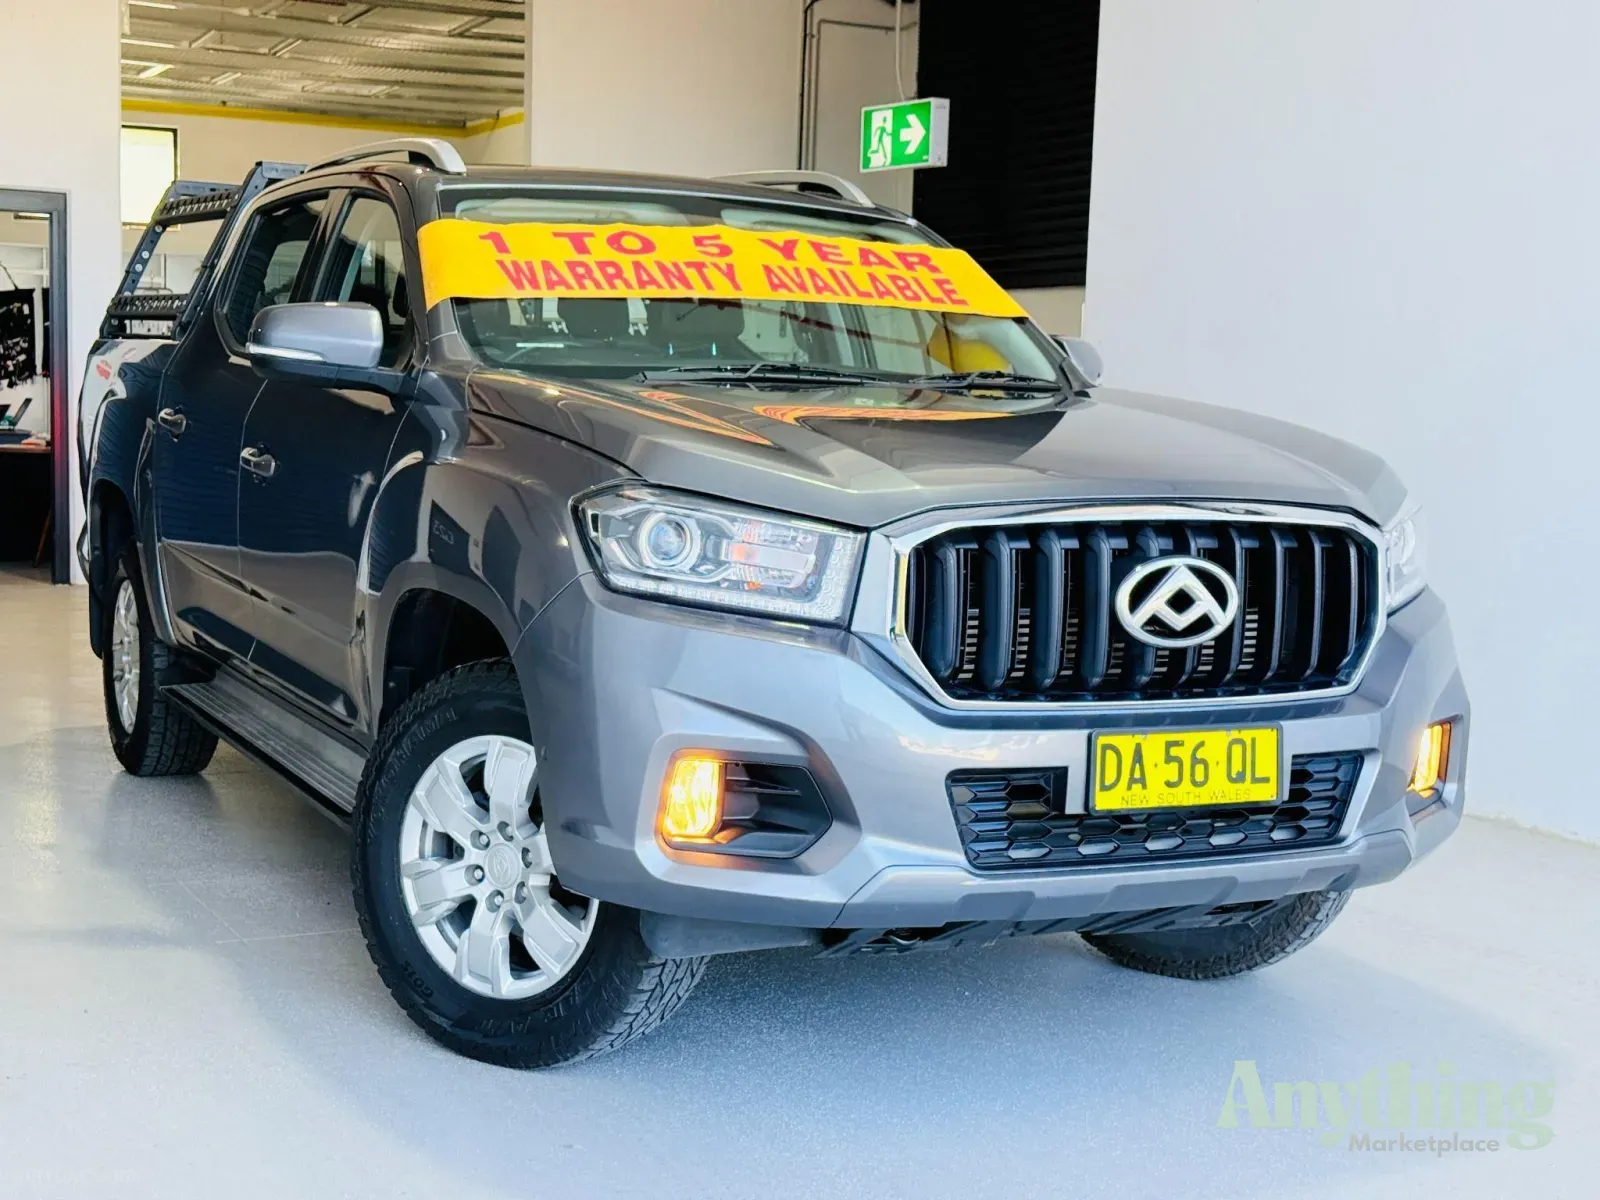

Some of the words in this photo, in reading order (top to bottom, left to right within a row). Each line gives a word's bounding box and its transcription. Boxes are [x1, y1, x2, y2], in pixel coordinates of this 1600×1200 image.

[478, 231, 512, 254] 1
[551, 231, 657, 255] TO
[692, 234, 734, 258] 5
[758, 238, 943, 274] YEAR
[495, 259, 743, 292] WARRANTY
[761, 263, 969, 306] AVAILABLE
[1099, 743, 1148, 792] DA
[1163, 740, 1210, 789] 56
[1226, 737, 1271, 785] QL
[1120, 794, 1150, 807] NEW
[1157, 791, 1201, 806] SOUTH
[1208, 787, 1252, 802] WALES
